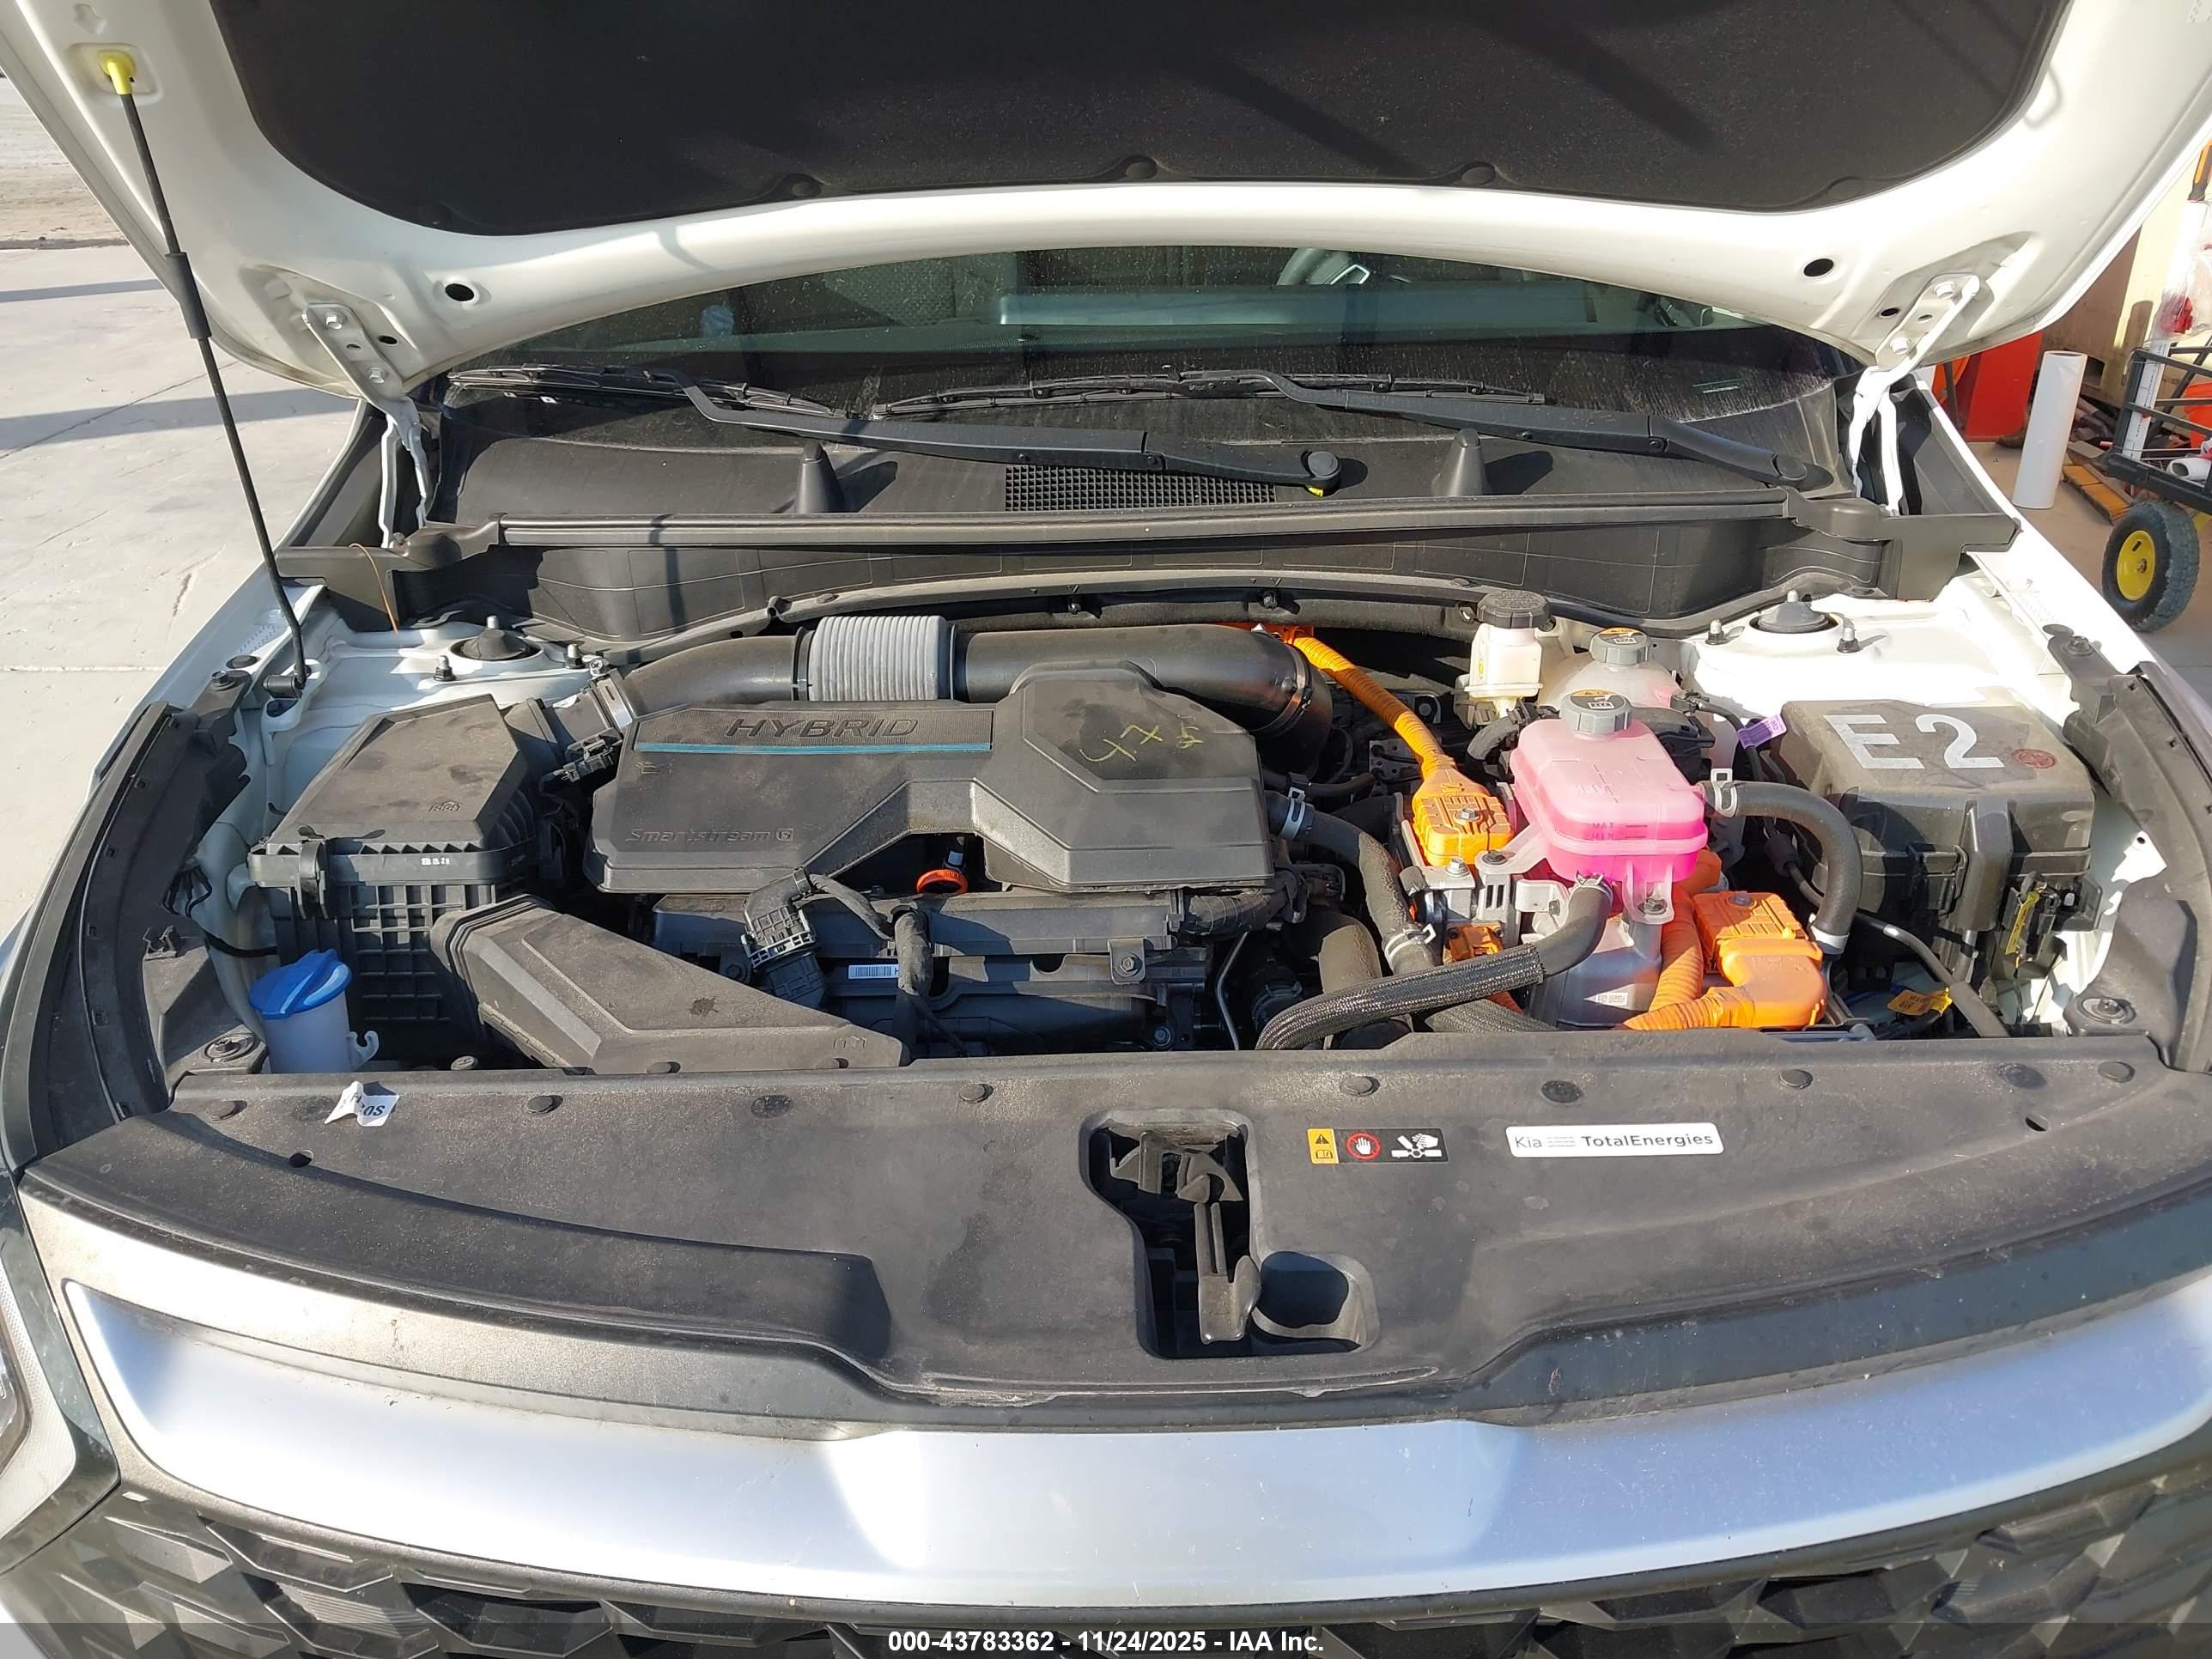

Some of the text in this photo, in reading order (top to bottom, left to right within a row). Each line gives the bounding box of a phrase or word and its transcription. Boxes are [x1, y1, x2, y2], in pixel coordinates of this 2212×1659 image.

[725, 718, 918, 738] HYBRID
[1515, 1133, 1713, 1148] Kia TotalEnergies
